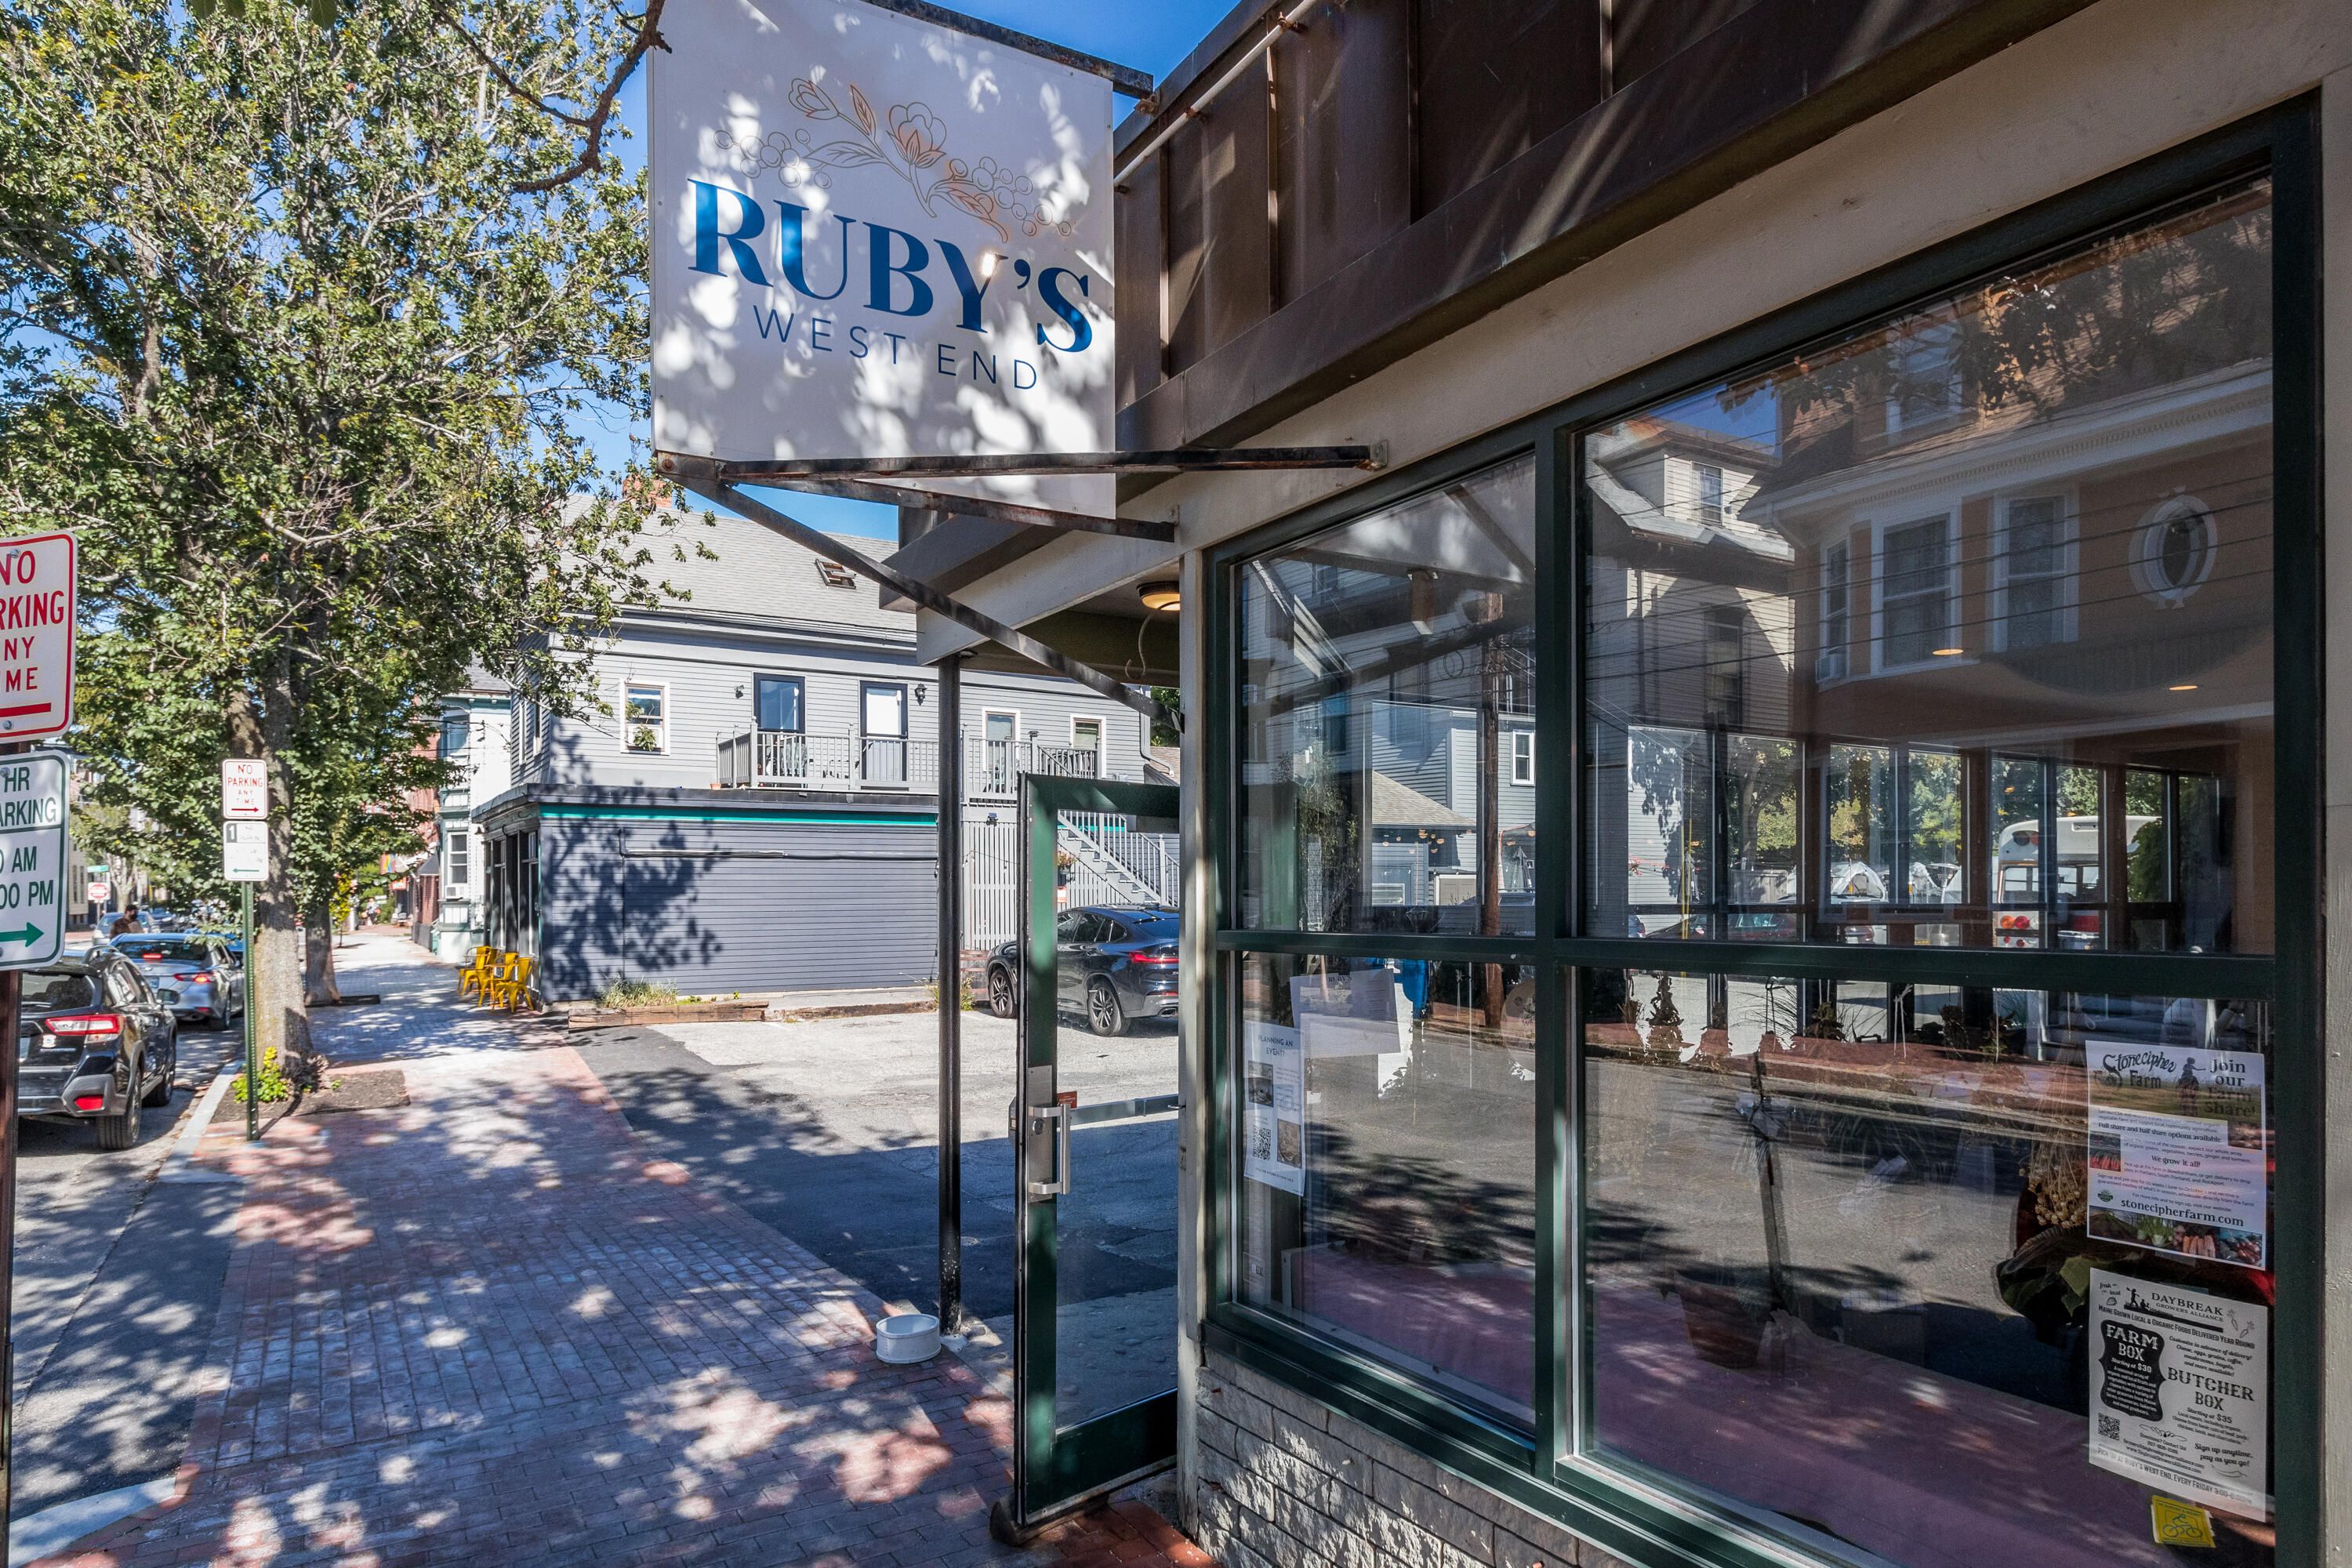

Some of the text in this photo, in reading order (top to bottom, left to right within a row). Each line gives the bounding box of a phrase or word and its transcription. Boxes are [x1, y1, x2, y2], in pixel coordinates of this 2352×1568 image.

[688, 178, 1093, 353] RUBY'S
[754, 305, 1037, 390] WEST END
[0, 550, 35, 586] NO
[0, 590, 64, 630] RKING
[4, 636, 34, 662] NY
[6, 666, 38, 692] ME
[4, 766, 30, 793] HR
[238, 764, 252, 775] NO
[227, 777, 263, 787] PARKING
[229, 826, 235, 840] 1
[11, 846, 38, 873] AM
[0, 880, 54, 909] 00 PM
[1258, 1034, 1293, 1047] PLANNING AN
[2103, 1051, 2177, 1074] Stonecipher
[2209, 1058, 2246, 1073] Join
[2129, 1069, 2162, 1089] Farm
[2215, 1075, 2245, 1087] our
[2168, 1131, 2191, 1140] options
[2121, 1199, 2244, 1226] stonecipherfarm.com
[2151, 1291, 2223, 1316] DAYBREAK
[2155, 1301, 2223, 1322] GROWERS ALLIANCE
[2098, 1304, 2113, 1314] MAINE
[2113, 1308, 2130, 1319] GROWN
[2131, 1313, 2146, 1323] LOCAL
[2151, 1318, 2173, 1330] ORGANIC
[2174, 1323, 2190, 1334] FOODS
[2191, 1327, 2219, 1341] DELIVERED
[2220, 1334, 2234, 1345] YEAR
[2235, 1338, 2255, 1349] ROUND
[2107, 1324, 2157, 1349] FARM
[2111, 1356, 2129, 1367] Starting
[2118, 1342, 2144, 1361] BOX
[2167, 1366, 2255, 1403] BUTCHER
[2195, 1391, 2223, 1411] BOX
[2216, 1413, 2233, 1425] $35
[2195, 1443, 2210, 1452] Sign
[2200, 1454, 2212, 1463] pay
[2144, 1463, 2158, 1474] WEST
[2173, 1472, 2190, 1485] EVERY
[2192, 1479, 2212, 1492] FRIDAY
